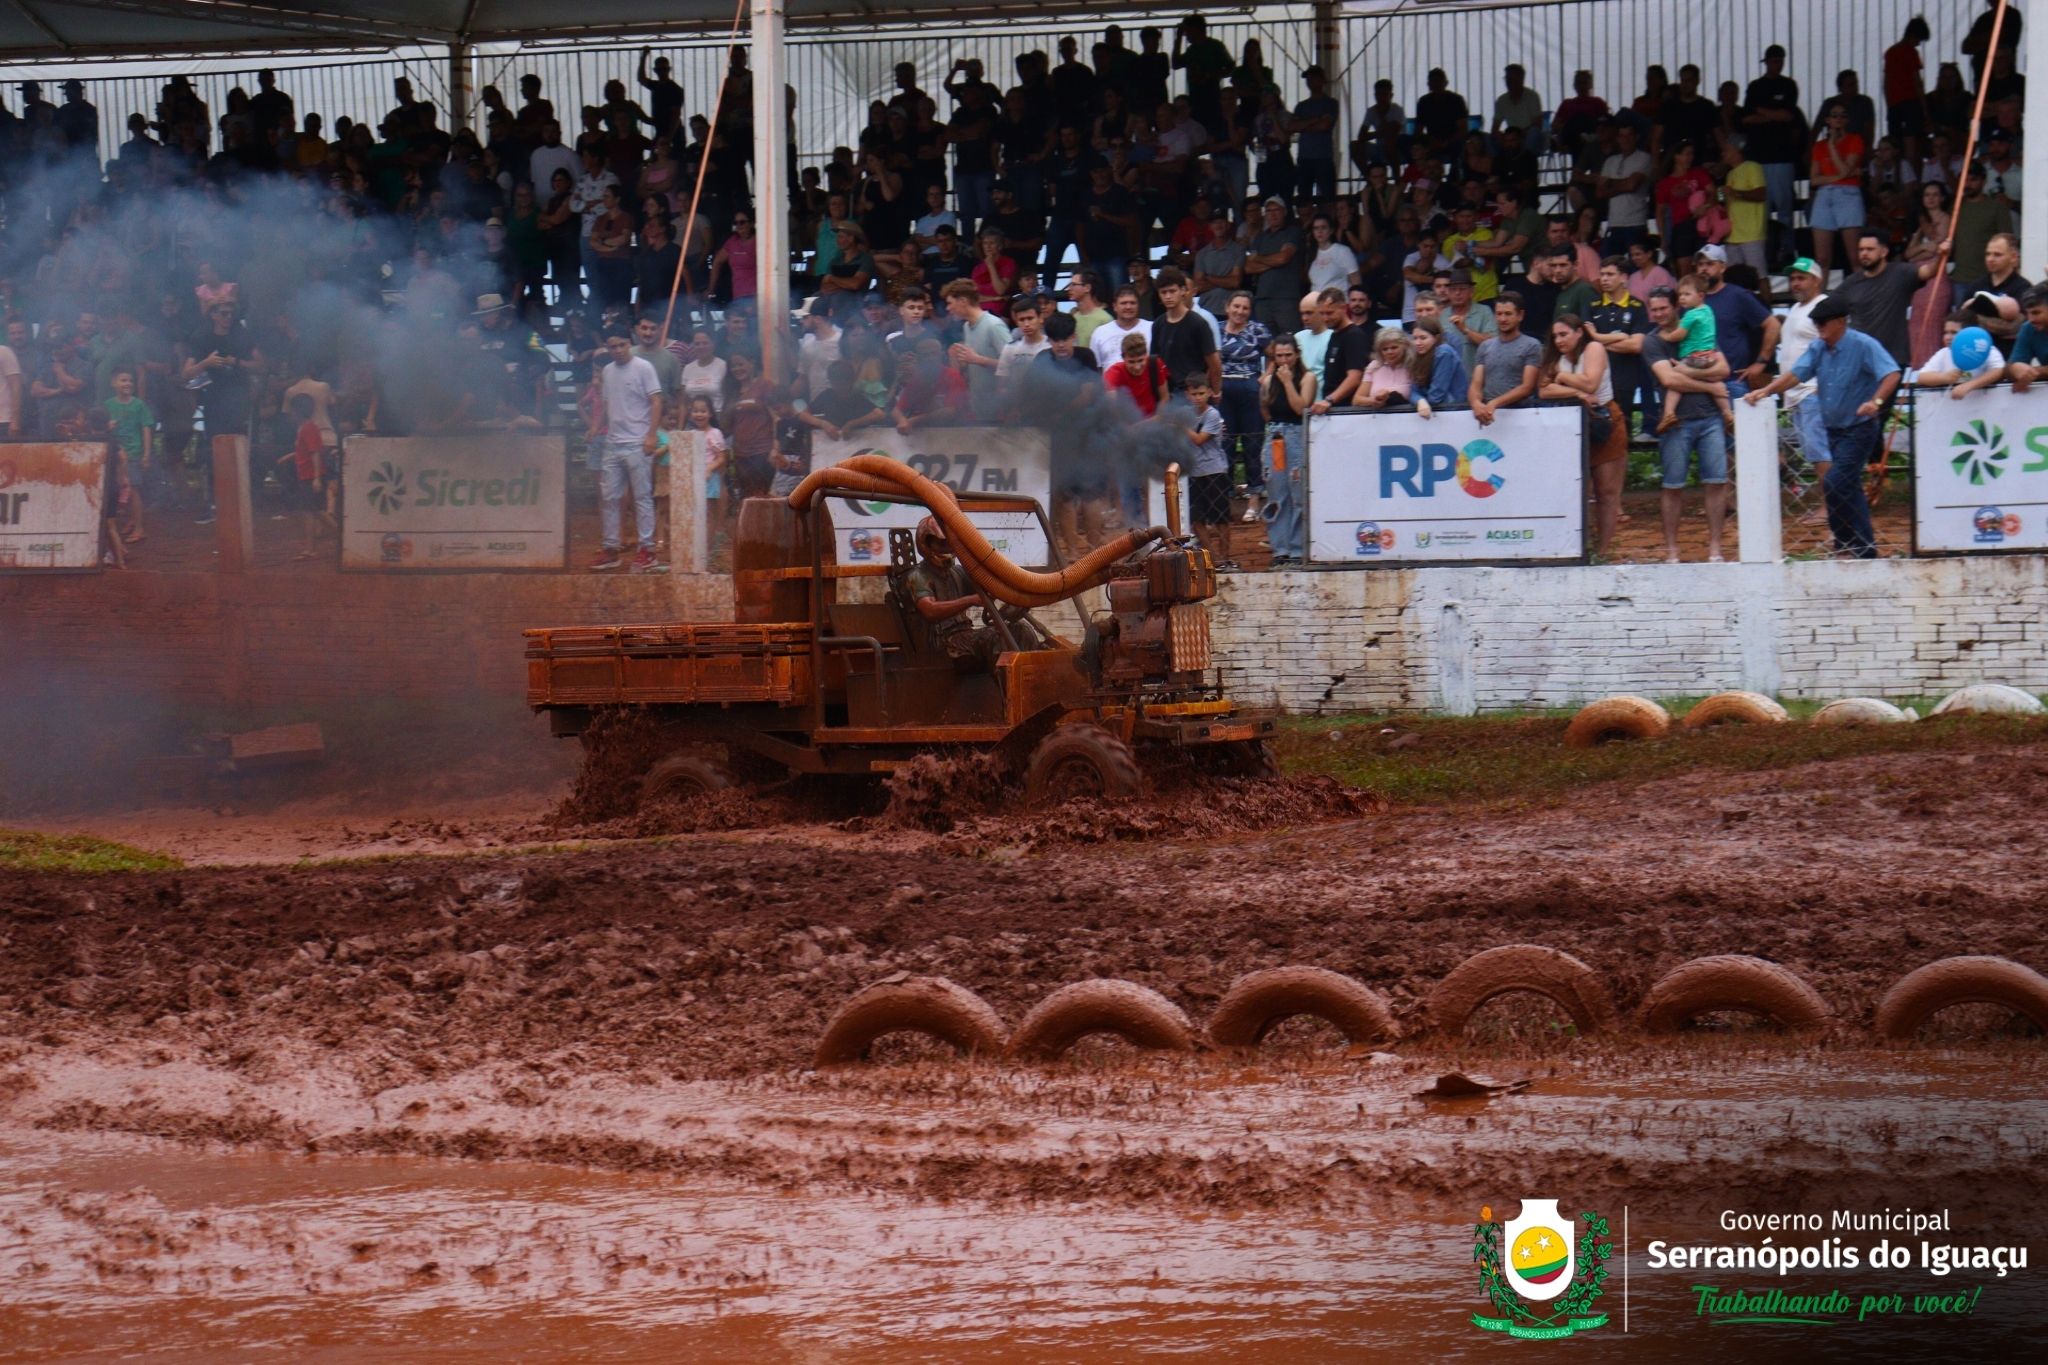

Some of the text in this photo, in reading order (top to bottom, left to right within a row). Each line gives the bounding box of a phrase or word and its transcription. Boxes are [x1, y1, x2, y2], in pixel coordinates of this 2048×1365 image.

[415, 467, 542, 506] Sicredi
[982, 467, 1018, 491] FM
[1379, 438, 1505, 498] RPC
